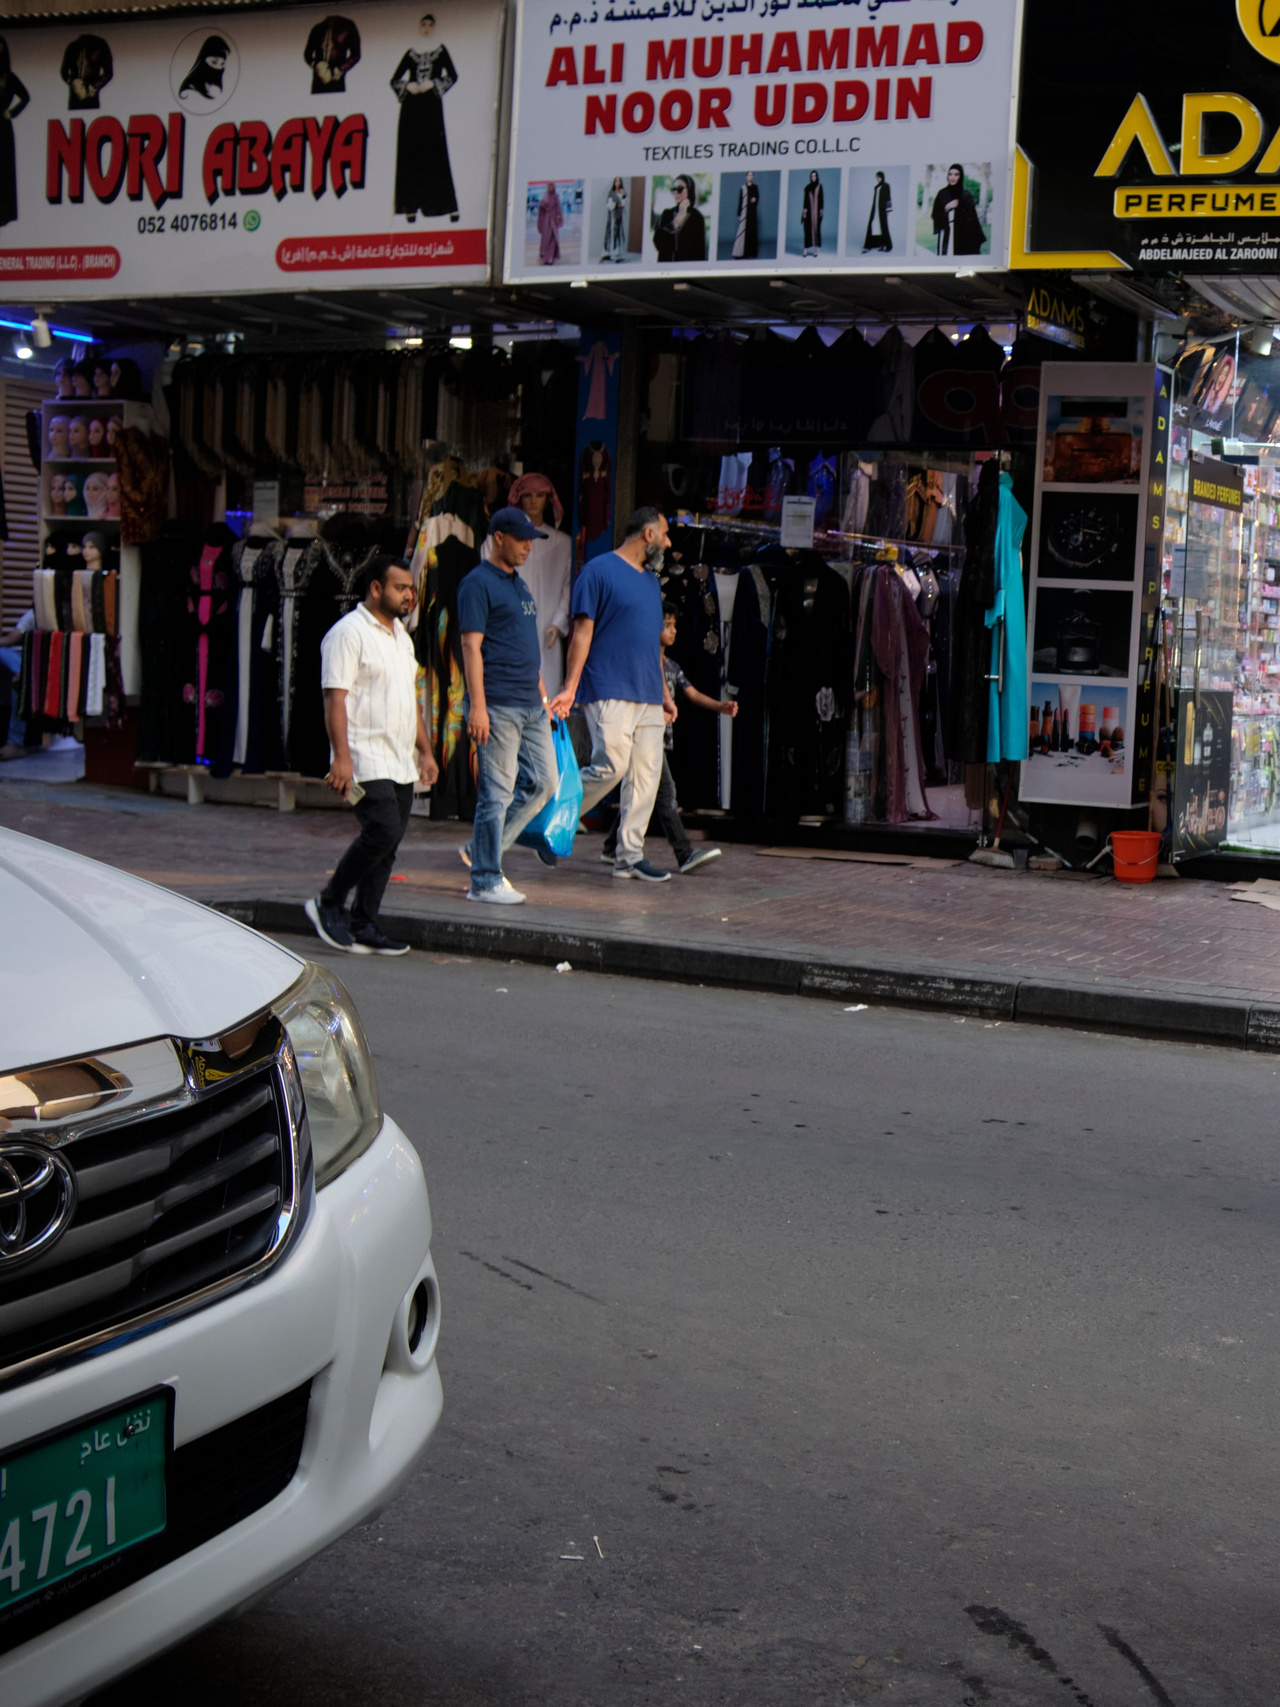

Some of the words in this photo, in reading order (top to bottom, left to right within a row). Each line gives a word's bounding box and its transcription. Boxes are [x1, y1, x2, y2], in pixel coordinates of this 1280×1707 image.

[545, 43, 625, 87] ALI
[645, 20, 985, 81] MUHAMMAD
[584, 87, 732, 136] NOOR
[753, 77, 933, 128] UDDIN
[46, 111, 186, 211] NORI
[202, 113, 370, 206] ABAYA
[642, 143, 713, 162] TEXTILES
[718, 140, 789, 158] TRADING
[794, 137, 861, 155] CO.L.L.C
[137, 216, 166, 234] 052
[170, 212, 238, 232] 4076814
[1138, 248, 1213, 260] ABDELMAJEED
[1214, 248, 1229, 260] AL
[1230, 247, 1278, 260] ZAROONI
[1027, 286, 1085, 333] ADAMS
[1193, 478, 1216, 500] BRANDED
[1216, 484, 1241, 506] PERFUMES
[0, 1474, 116, 1593] 4721
